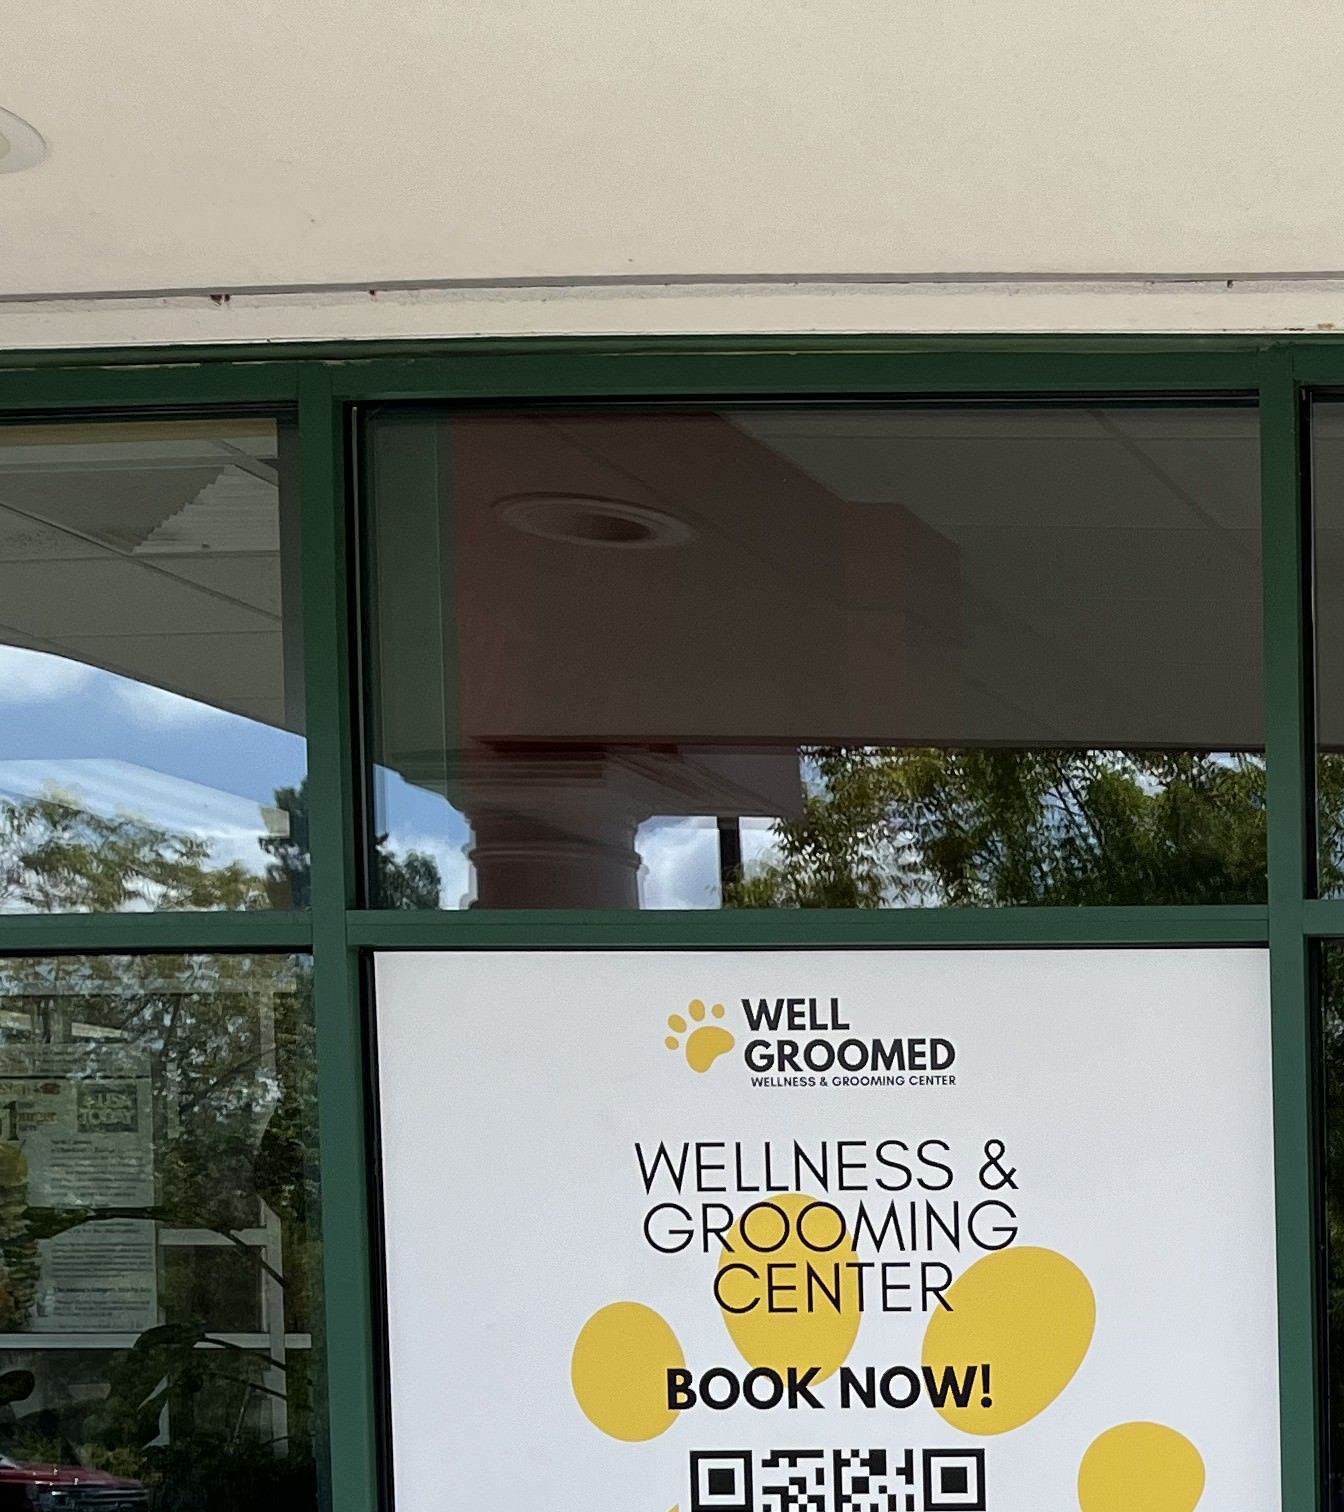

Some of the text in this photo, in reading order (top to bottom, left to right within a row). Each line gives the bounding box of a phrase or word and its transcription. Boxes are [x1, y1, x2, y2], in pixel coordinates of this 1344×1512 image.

[741, 998, 849, 1031] WELL
[745, 1038, 955, 1072] GROOMED
[751, 1076, 955, 1087] WELLNESS & GROOMING CENTER
[635, 1139, 1019, 1195] WELLNESS &
[643, 1200, 1018, 1253] GROOMING
[714, 1263, 954, 1314] CENTER
[667, 1364, 994, 1411] BOOK NOW!
